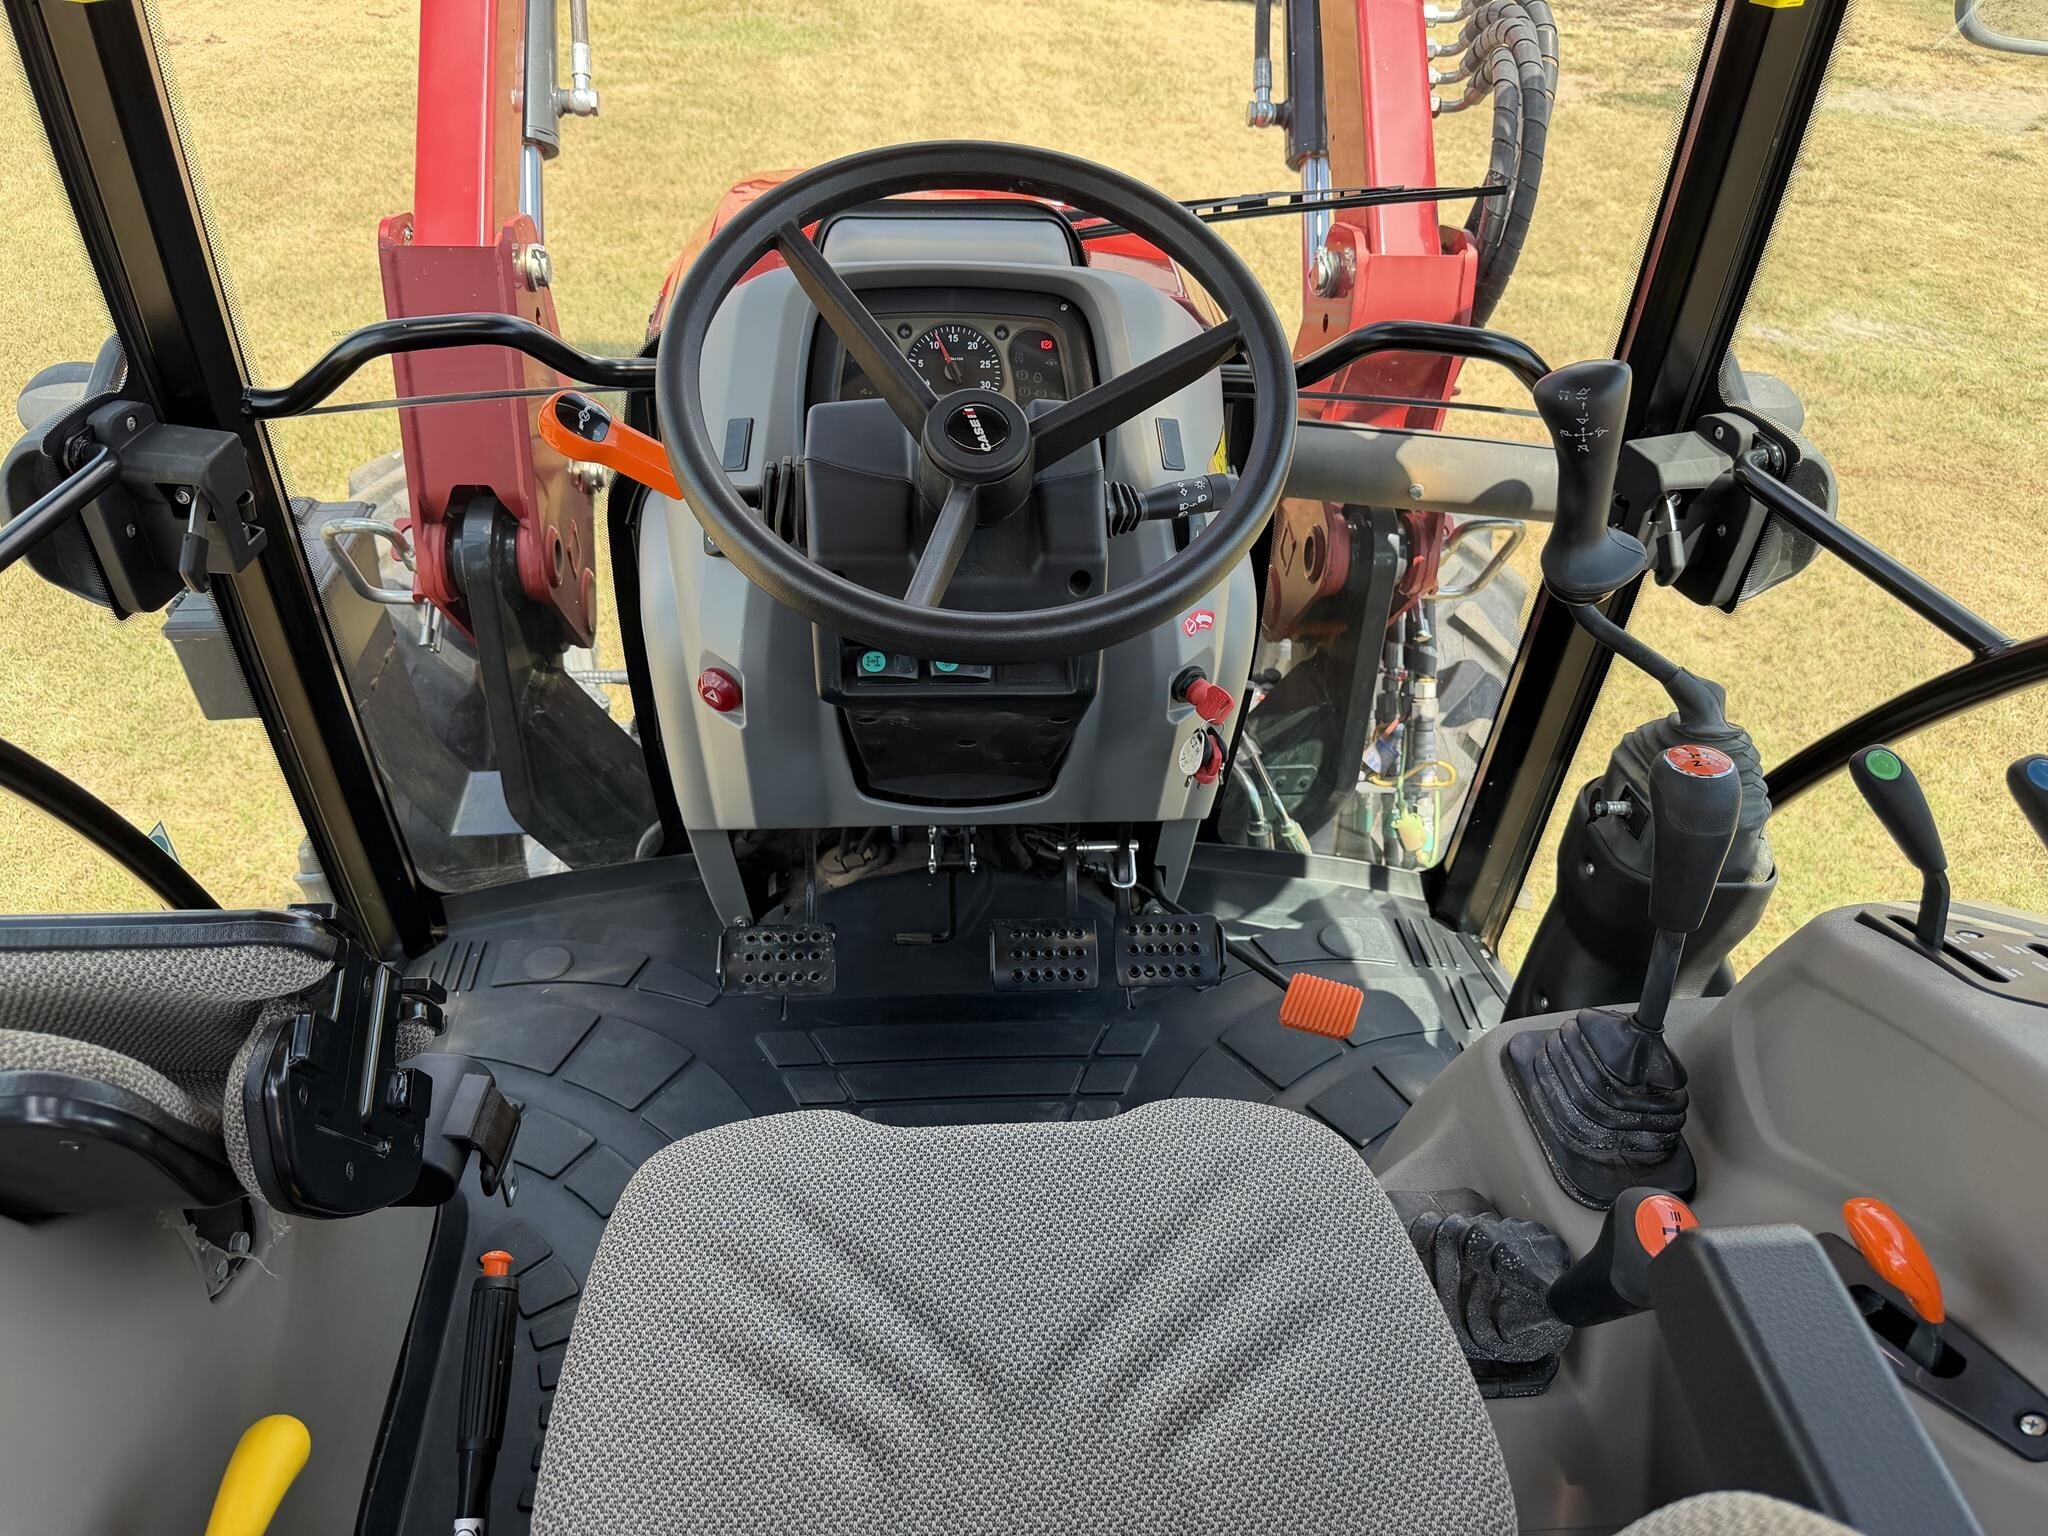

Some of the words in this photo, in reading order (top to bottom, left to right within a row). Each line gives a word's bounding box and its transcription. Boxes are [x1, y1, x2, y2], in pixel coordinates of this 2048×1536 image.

[948, 334, 959, 343] 15
[929, 341, 940, 350] 10
[967, 341, 979, 350] 20
[918, 359, 924, 367] 5
[980, 360, 991, 368] 25
[980, 380, 991, 389] 30
[969, 419, 991, 451] CASE
